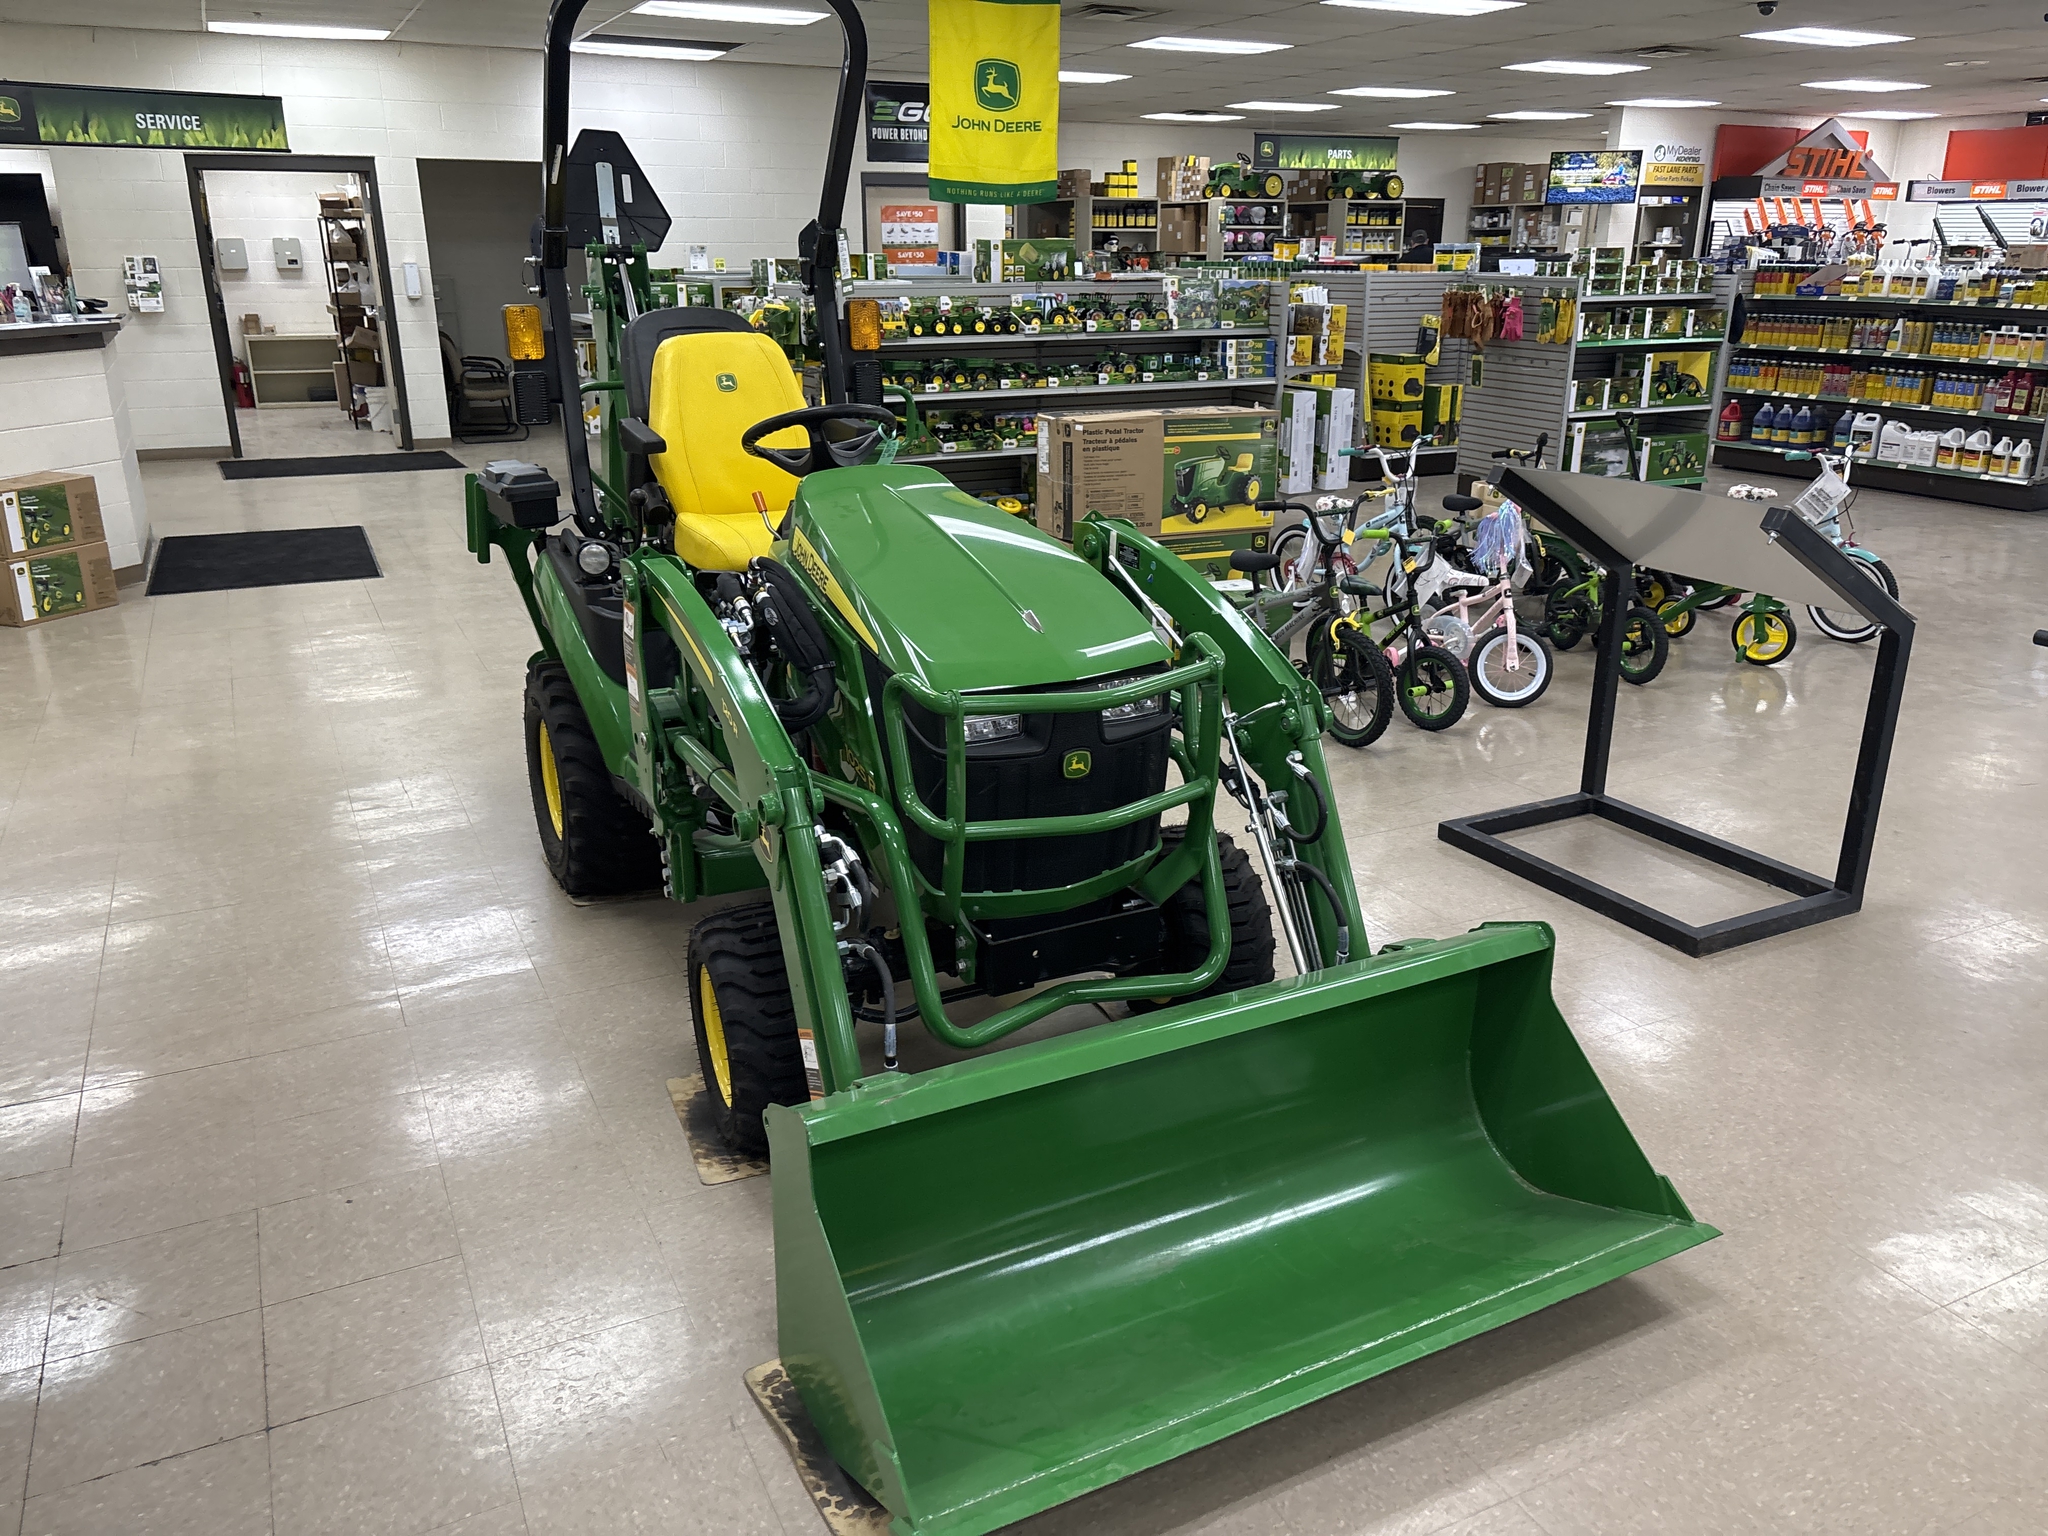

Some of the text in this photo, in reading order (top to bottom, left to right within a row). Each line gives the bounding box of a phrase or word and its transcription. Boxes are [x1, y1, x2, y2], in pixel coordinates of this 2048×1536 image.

[872, 101, 930, 122] EG
[135, 113, 202, 131] SERVICE
[952, 115, 1042, 133] JOHN DEERE
[872, 127, 928, 141] POWER BEYOND
[1327, 149, 1353, 160] PARTS
[1666, 145, 1702, 157] MyDealer
[1783, 146, 1867, 178] STIHL
[1682, 166, 1698, 174] PARTS
[946, 187, 978, 197] NOTHING
[979, 189, 998, 198] RUNS
[1764, 183, 1796, 192] Chain Saws
[1803, 184, 1825, 193] STIHL
[1837, 186, 1867, 194] Chain Saws
[1873, 186, 1894, 195] STIHL
[1926, 187, 1956, 195] Blowers
[1972, 185, 2003, 194] STIHL
[2016, 184, 2043, 193] Blower
[896, 210, 912, 218] SAVE
[1092, 445, 1120, 453] plastique
[793, 538, 829, 594] JOHN DEERE
[1274, 612, 1306, 641] MUD MACHINE
